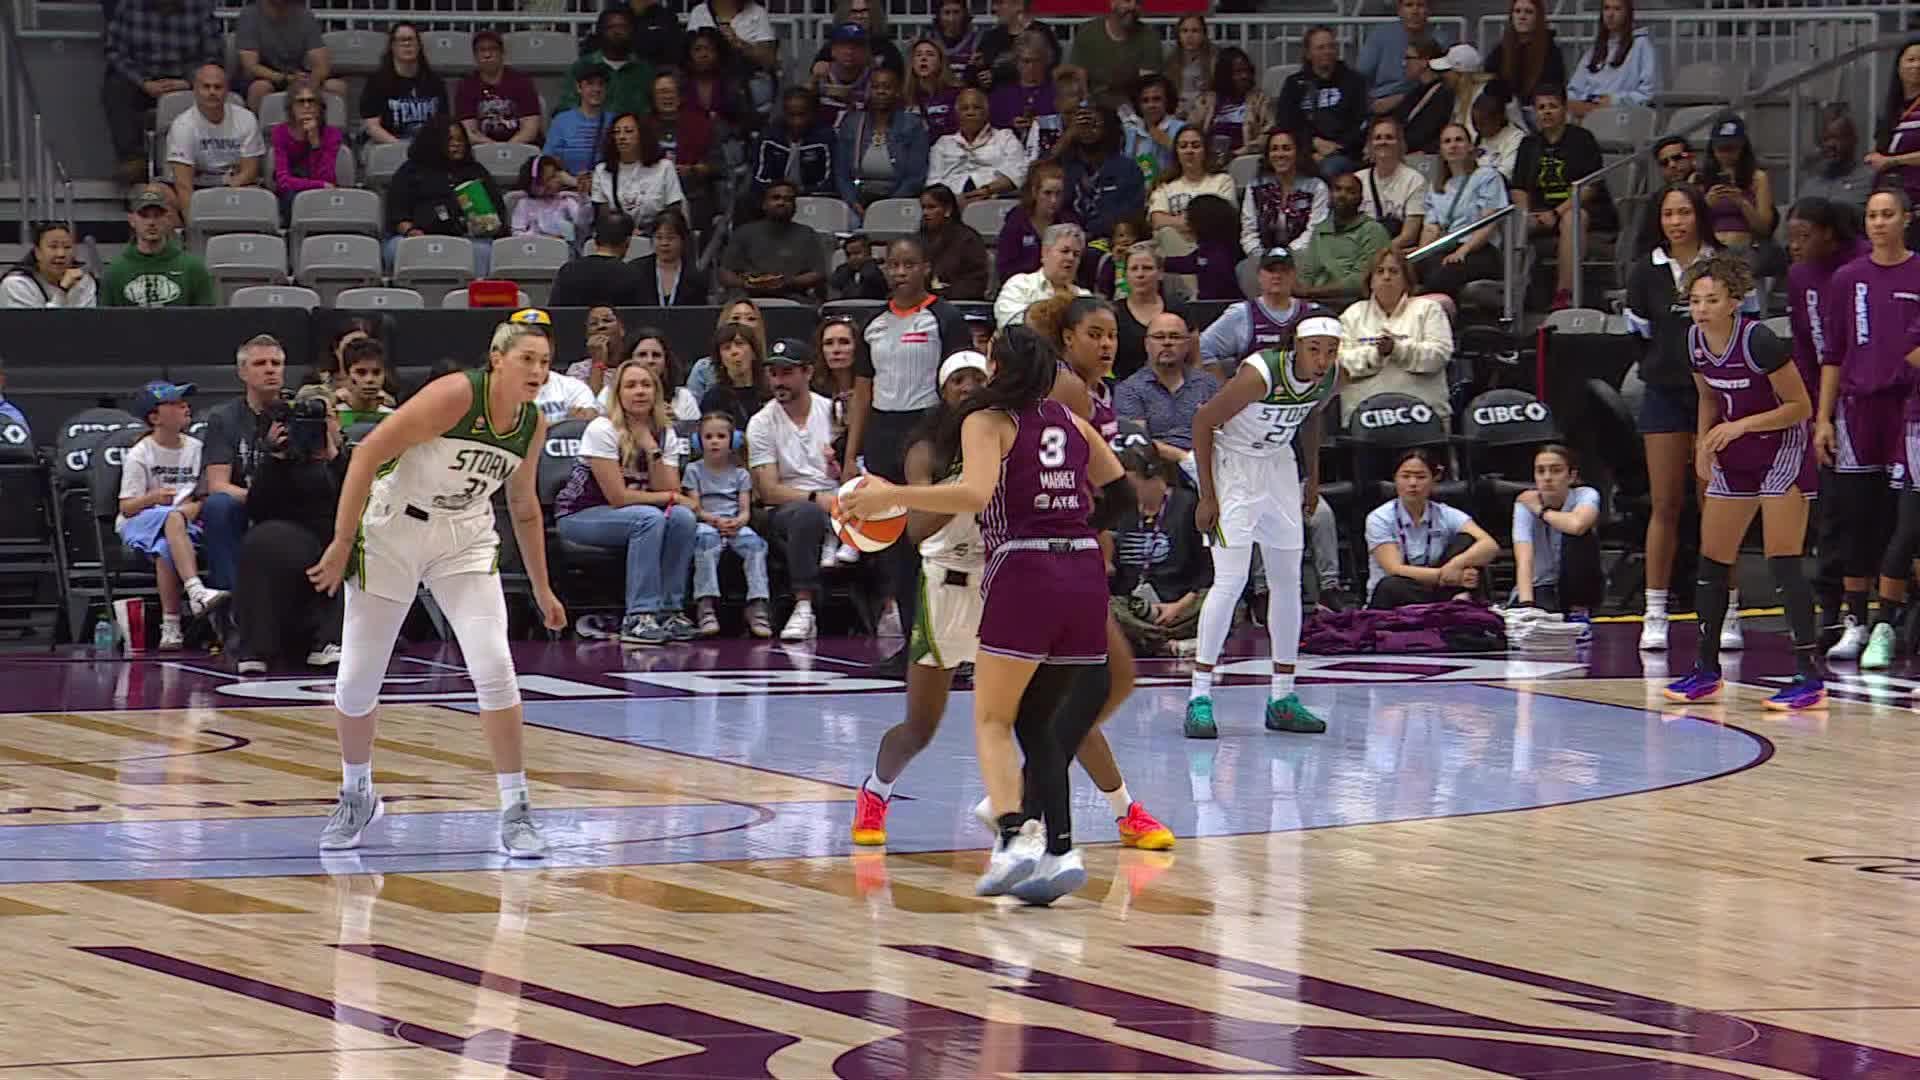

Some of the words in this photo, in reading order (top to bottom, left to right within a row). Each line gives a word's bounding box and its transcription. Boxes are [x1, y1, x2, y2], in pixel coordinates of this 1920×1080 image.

[1258, 406, 1313, 423] STOR
[1359, 406, 1412, 428] CIBC
[1473, 404, 1525, 425] CIBC
[545, 437, 582, 457] CIB
[1038, 426, 1068, 468] 3
